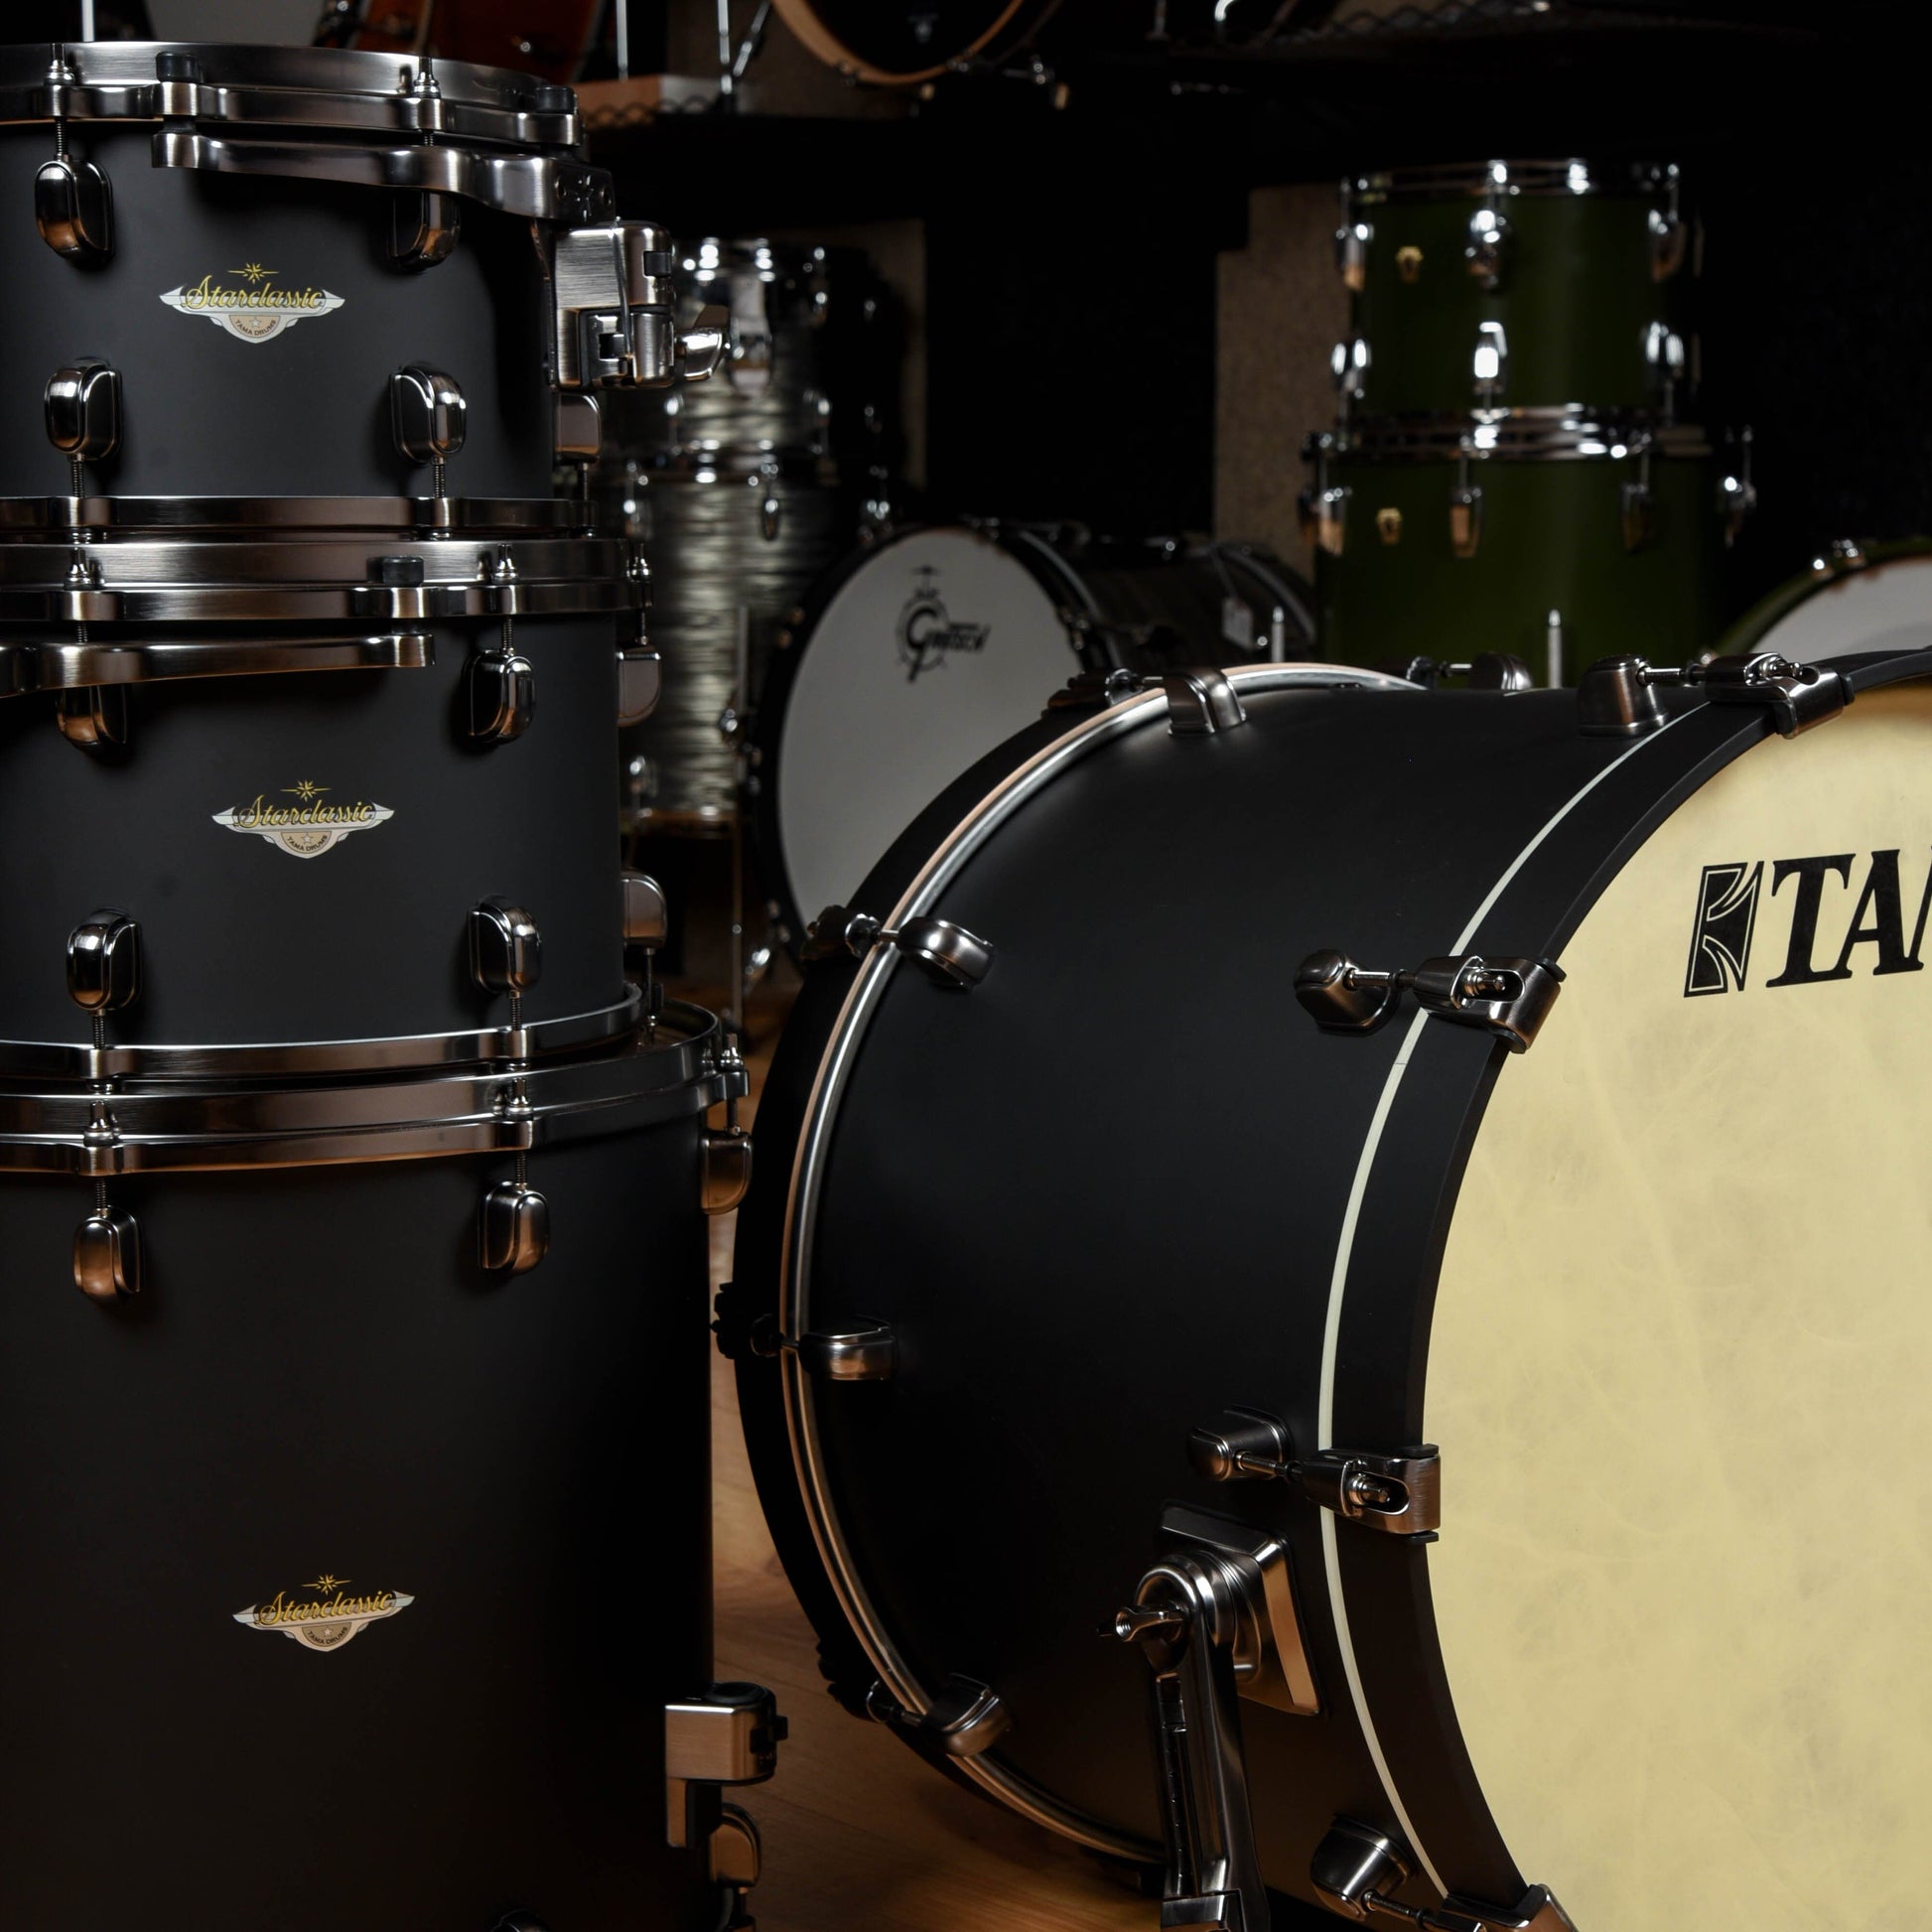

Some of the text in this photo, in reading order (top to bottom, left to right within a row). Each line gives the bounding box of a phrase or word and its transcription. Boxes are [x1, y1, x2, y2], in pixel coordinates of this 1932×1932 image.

[181, 275, 324, 309] Starclassic
[234, 319, 277, 336] TAMA DRUMS
[233, 794, 373, 828] Starclassic
[286, 834, 329, 852] TAMA DRUMS
[1765, 846, 1932, 988] TA
[253, 1590, 393, 1625] Starclassic
[307, 1630, 326, 1645] TAMA
